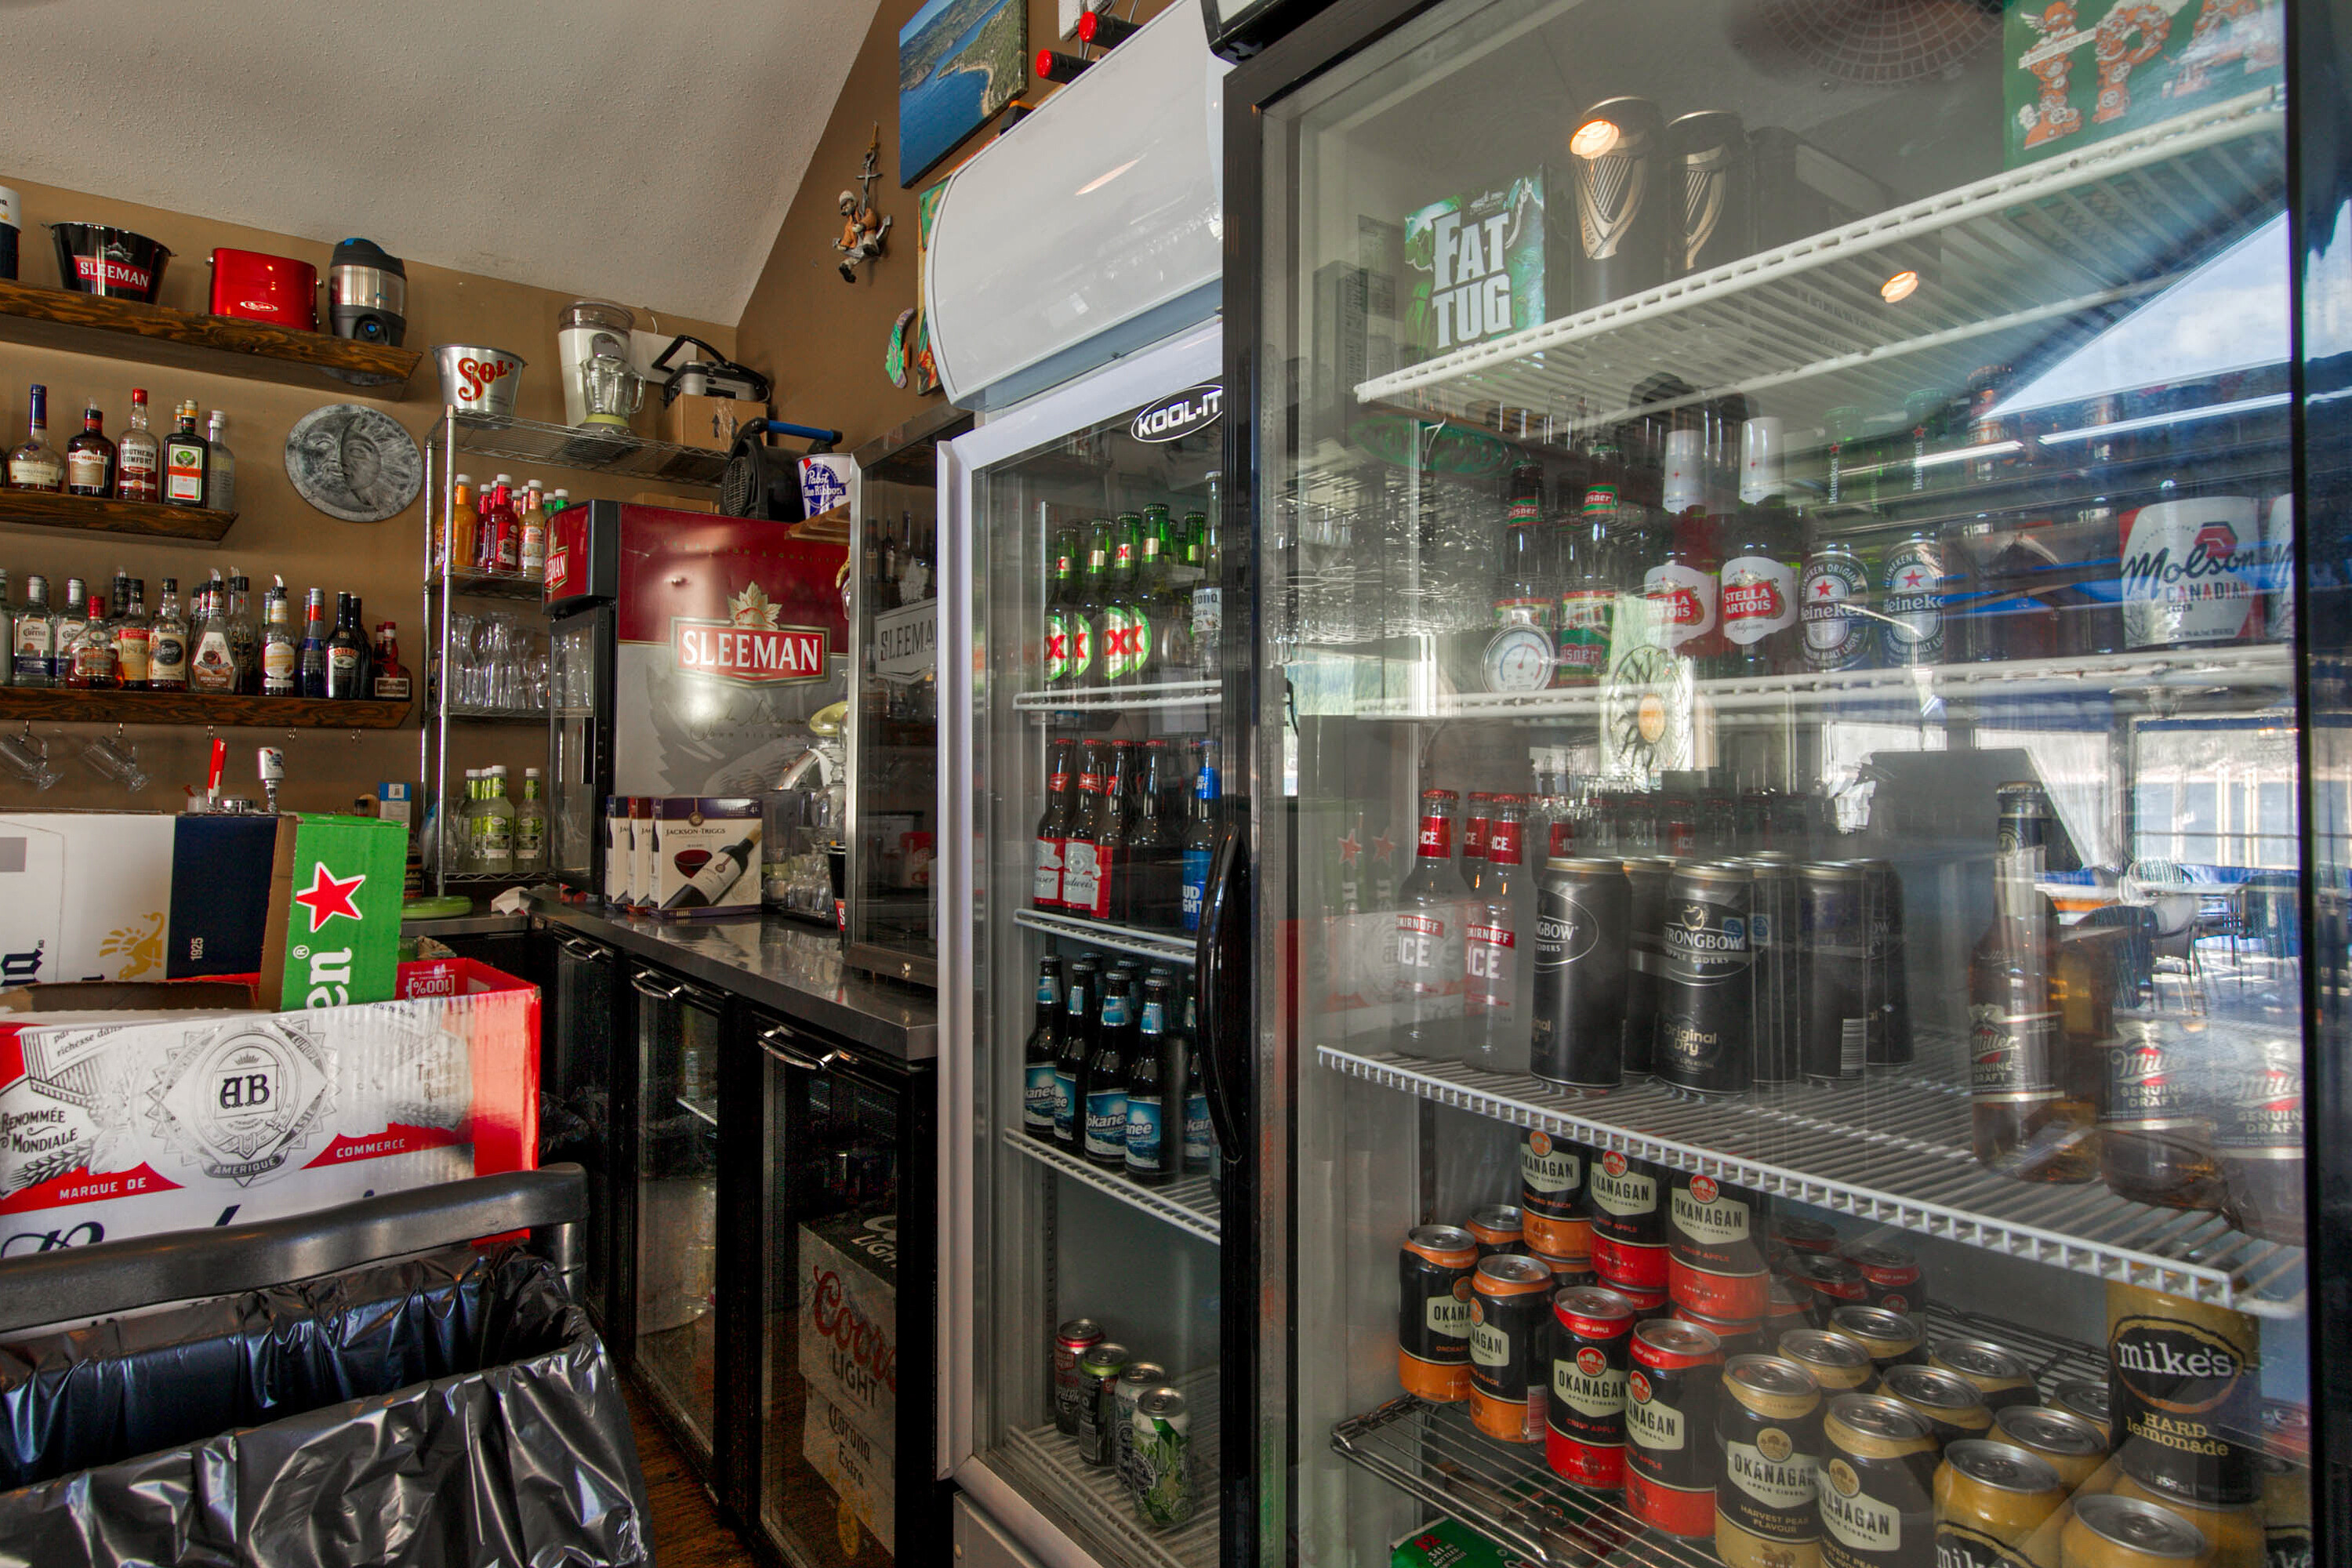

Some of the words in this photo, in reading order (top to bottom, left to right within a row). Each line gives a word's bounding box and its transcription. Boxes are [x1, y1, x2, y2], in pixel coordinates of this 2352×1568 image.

[1432, 211, 1510, 292] FAT
[80, 262, 149, 288] SLEEMAN
[1432, 273, 1512, 350] TUG
[1138, 390, 1222, 439] KOOL-IT
[1828, 458, 1838, 504] Heineken
[2120, 544, 2254, 600] Molson
[1726, 588, 1770, 603] STELLA
[1884, 595, 1944, 612] Heineke
[2167, 582, 2249, 603] CANADIAN
[1726, 600, 1771, 614] ARTOIS
[683, 630, 818, 672] SLEEMAN
[880, 618, 936, 662] SLEEMA
[1421, 831, 1438, 845] ICE
[1492, 837, 1509, 851] ICE
[1183, 886, 1200, 898] UD
[191, 938, 204, 961] 1925
[1398, 935, 1430, 967] ICE
[1664, 927, 1744, 950] TRONGBOW
[1467, 947, 1501, 980] ICE
[1691, 955, 1729, 964] CIDERS
[56, 1033, 95, 1058] richesse
[1663, 1022, 1717, 1046] Original
[1675, 1038, 1699, 1056] Dry
[220, 1073, 270, 1109] AB
[2, 1106, 66, 1133] RENOMMÉE
[2238, 1110, 2303, 1122] GENUIN
[12, 1128, 78, 1153] MONDIALE
[336, 1138, 405, 1158] COMMERCE
[59, 1181, 118, 1200] MARQUE
[127, 1178, 147, 1189] DE
[1592, 1171, 1649, 1201] OKANAGAN
[1675, 1196, 1742, 1228] OKANAGAN
[1434, 1305, 1471, 1322] OKANA
[2117, 1341, 2234, 1378] mike's
[833, 1347, 878, 1408] LIGHT
[1559, 1370, 1626, 1398] OKANAGAN
[829, 1402, 870, 1462] Corona
[2127, 1415, 2229, 1457] lemonade
[2143, 1411, 2207, 1439] HARD
[1740, 1504, 1782, 1523] HARVEST
[1753, 1519, 1797, 1533] FLAVOUR
[1414, 1534, 1443, 1553] 12
